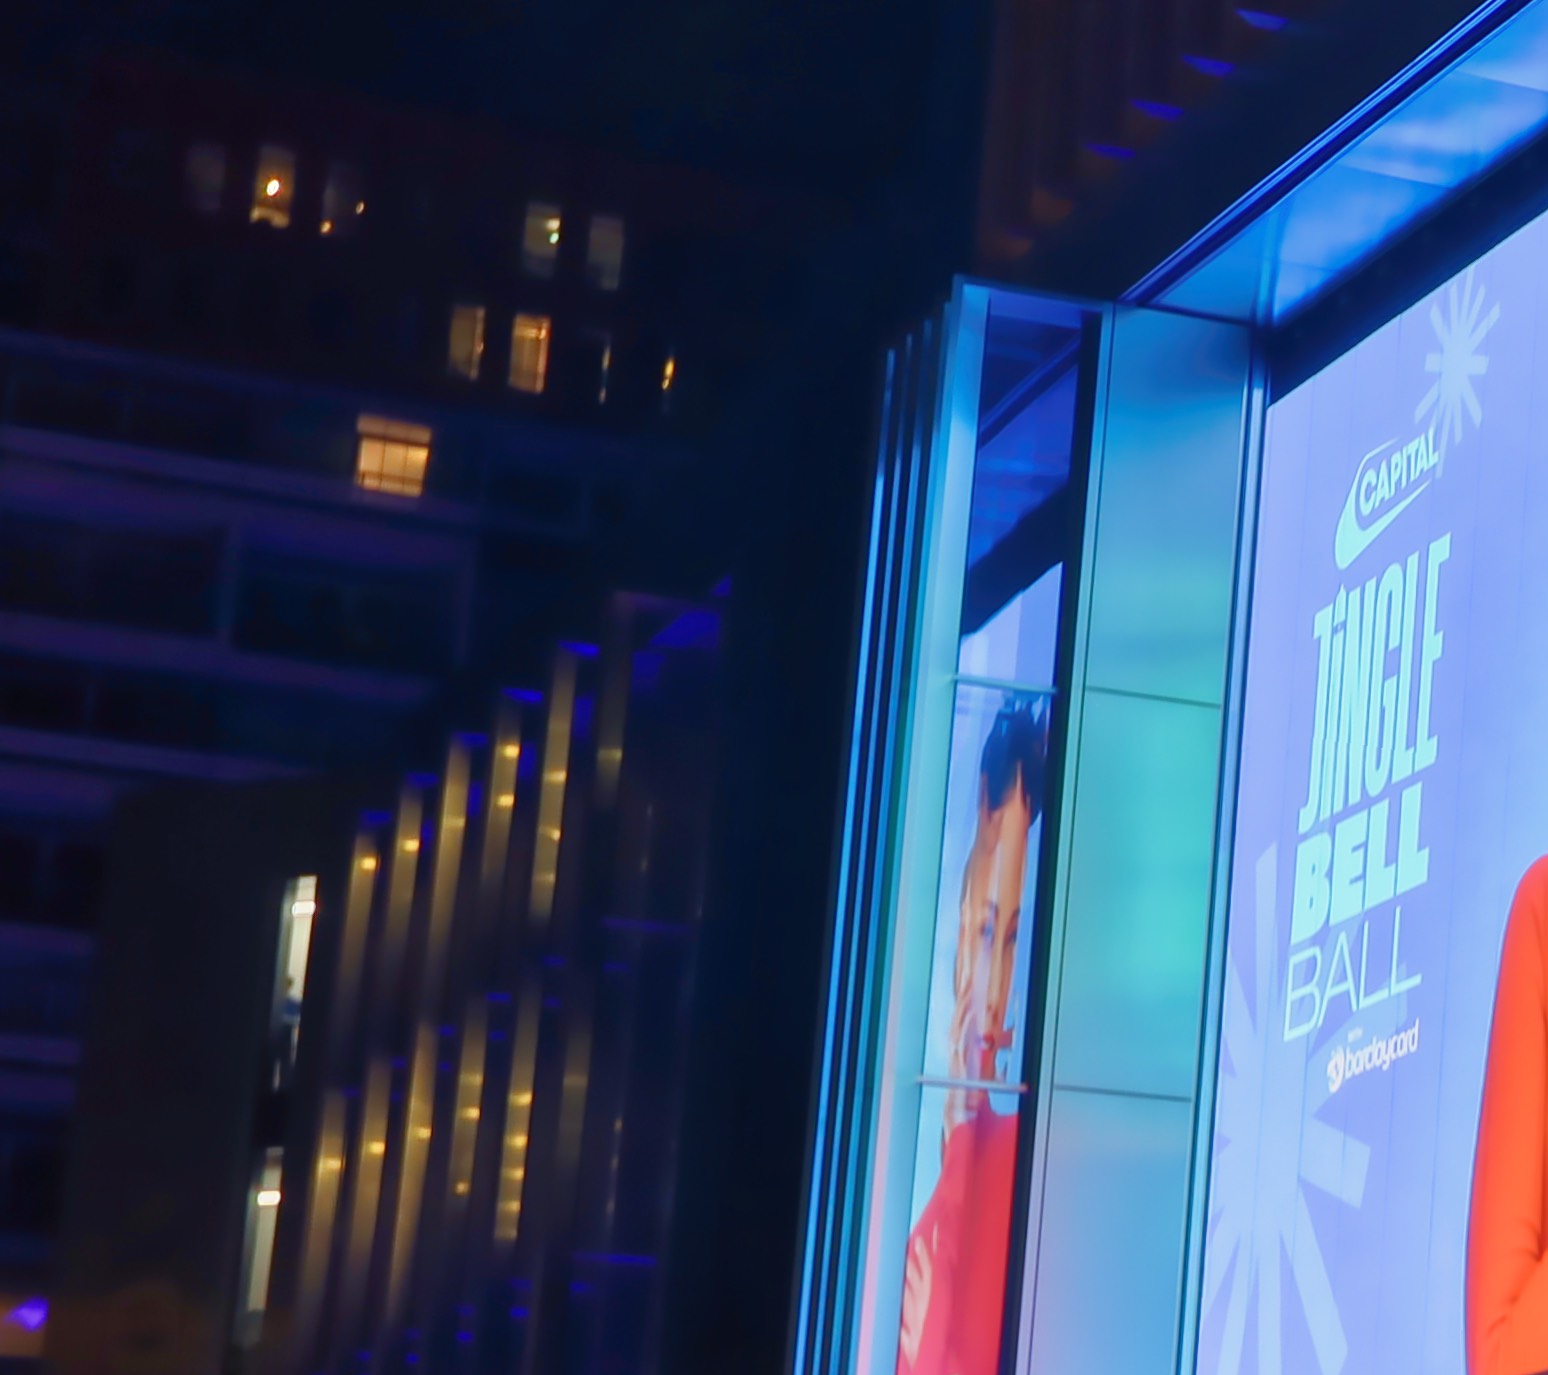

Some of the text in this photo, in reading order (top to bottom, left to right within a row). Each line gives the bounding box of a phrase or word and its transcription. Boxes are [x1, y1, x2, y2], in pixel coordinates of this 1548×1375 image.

[1359, 427, 1440, 517] CAPITAL
[1290, 781, 1430, 946] BELL
[1283, 905, 1423, 1043] BALL
[1345, 1016, 1420, 1080] barclaycard
